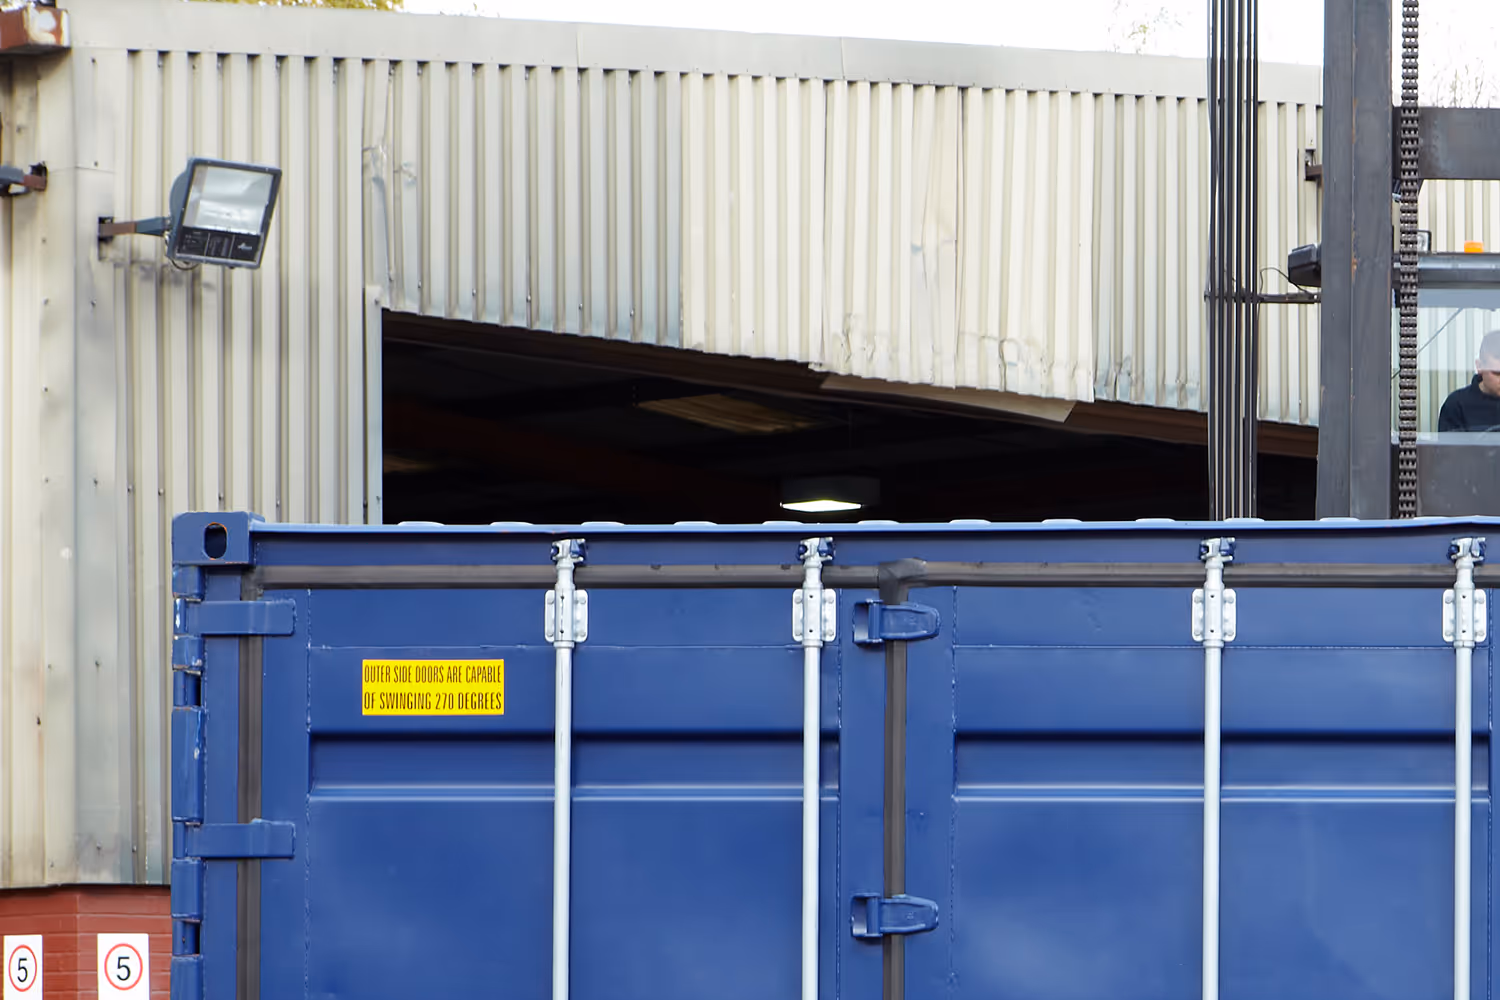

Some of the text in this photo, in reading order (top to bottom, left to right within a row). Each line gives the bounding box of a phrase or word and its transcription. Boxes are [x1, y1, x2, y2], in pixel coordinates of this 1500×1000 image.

[364, 665, 501, 683] OUTER SIDE DOORS ARE CAPABLE
[363, 692, 502, 710] OF SWINGING 270 DEGREES
[17, 957, 28, 982] 5
[116, 956, 131, 981] 5
